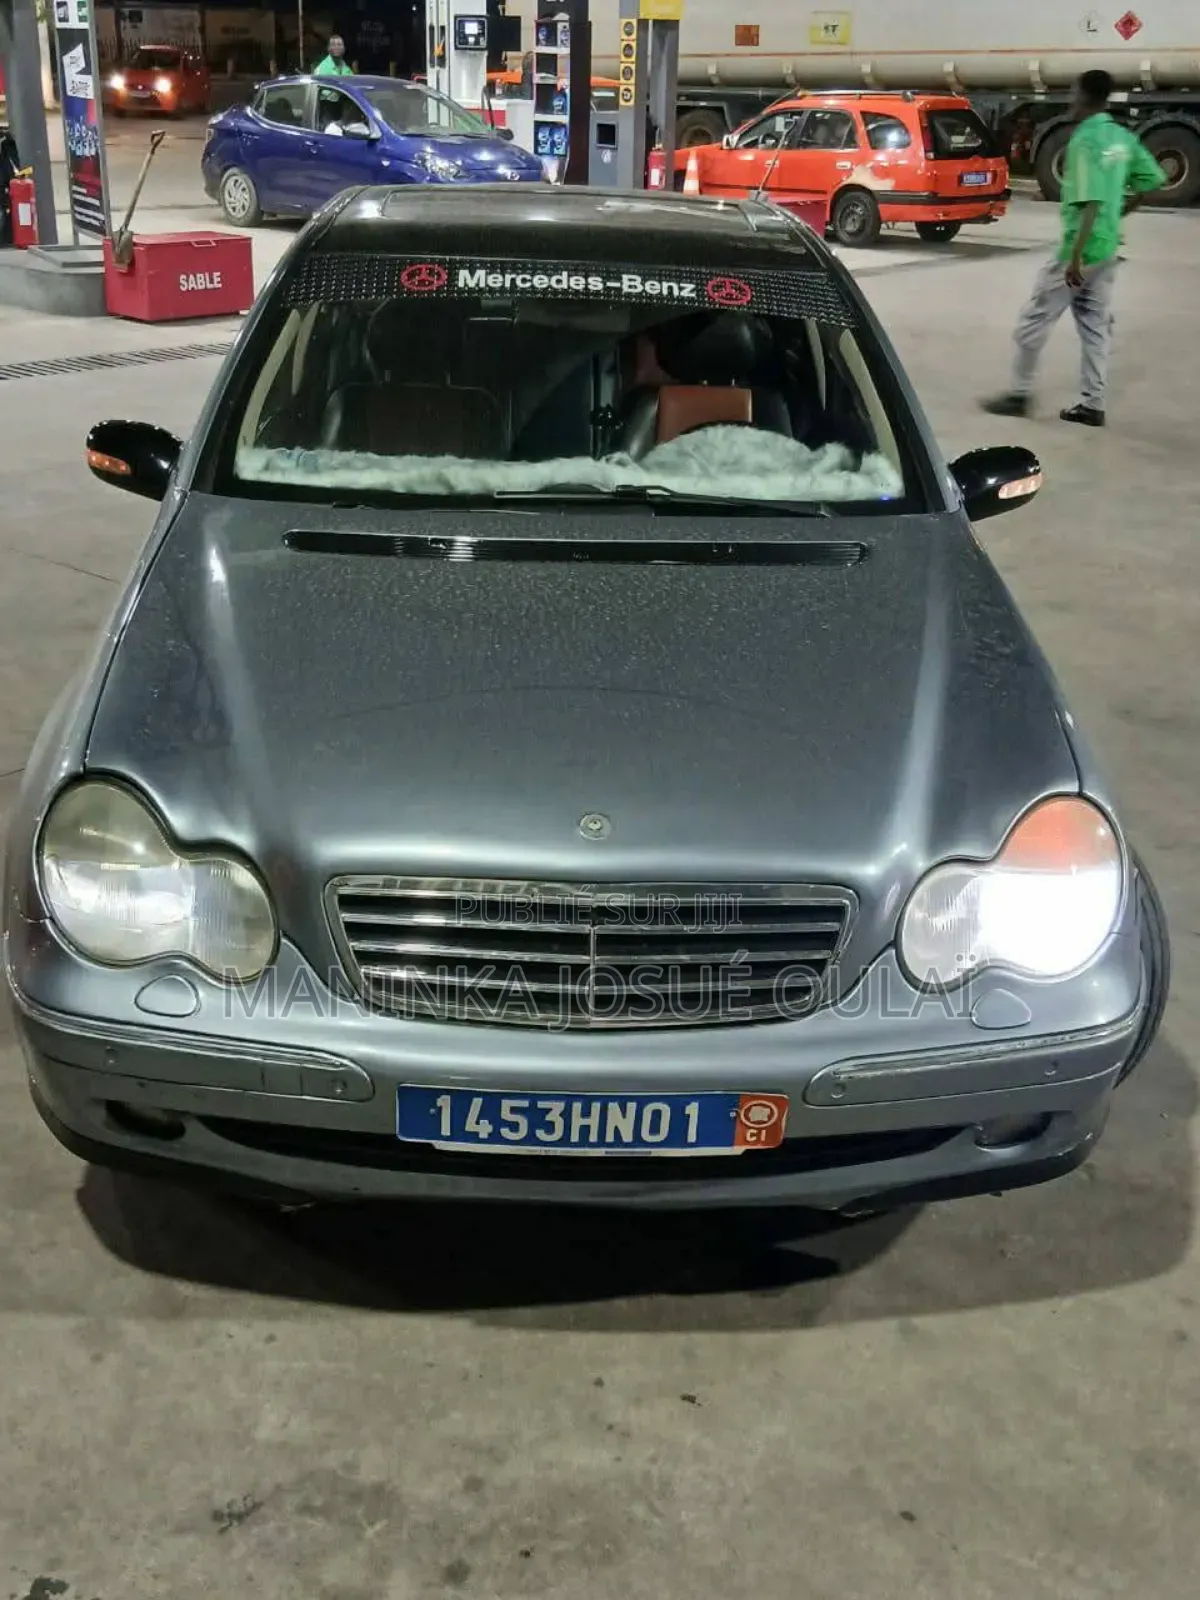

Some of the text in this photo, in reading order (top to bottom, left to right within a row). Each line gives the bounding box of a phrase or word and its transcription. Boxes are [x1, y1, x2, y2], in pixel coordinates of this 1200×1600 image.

[179, 271, 222, 292] SABLE
[457, 269, 697, 298] Mercedes-Benz
[745, 1129, 767, 1142] CI
